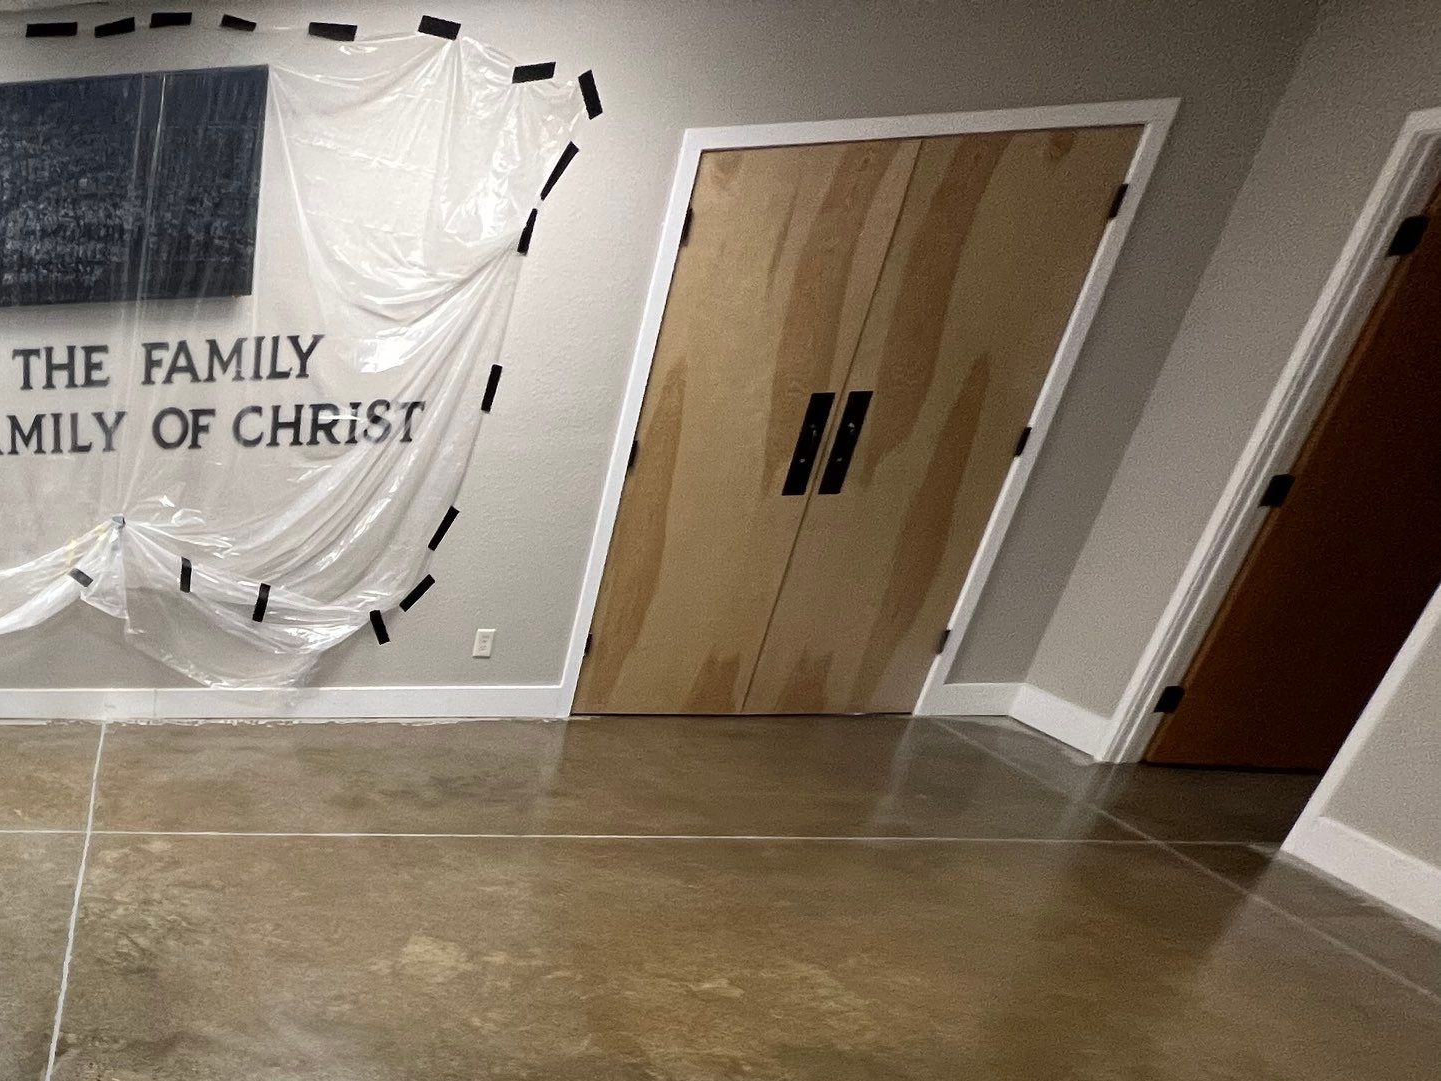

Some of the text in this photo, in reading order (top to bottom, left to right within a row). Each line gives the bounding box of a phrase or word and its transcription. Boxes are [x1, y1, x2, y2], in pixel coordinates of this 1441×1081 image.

[12, 344, 110, 391] THE
[141, 334, 325, 385] FAMILY
[152, 406, 216, 449] OF
[232, 399, 425, 447] CHRIST
